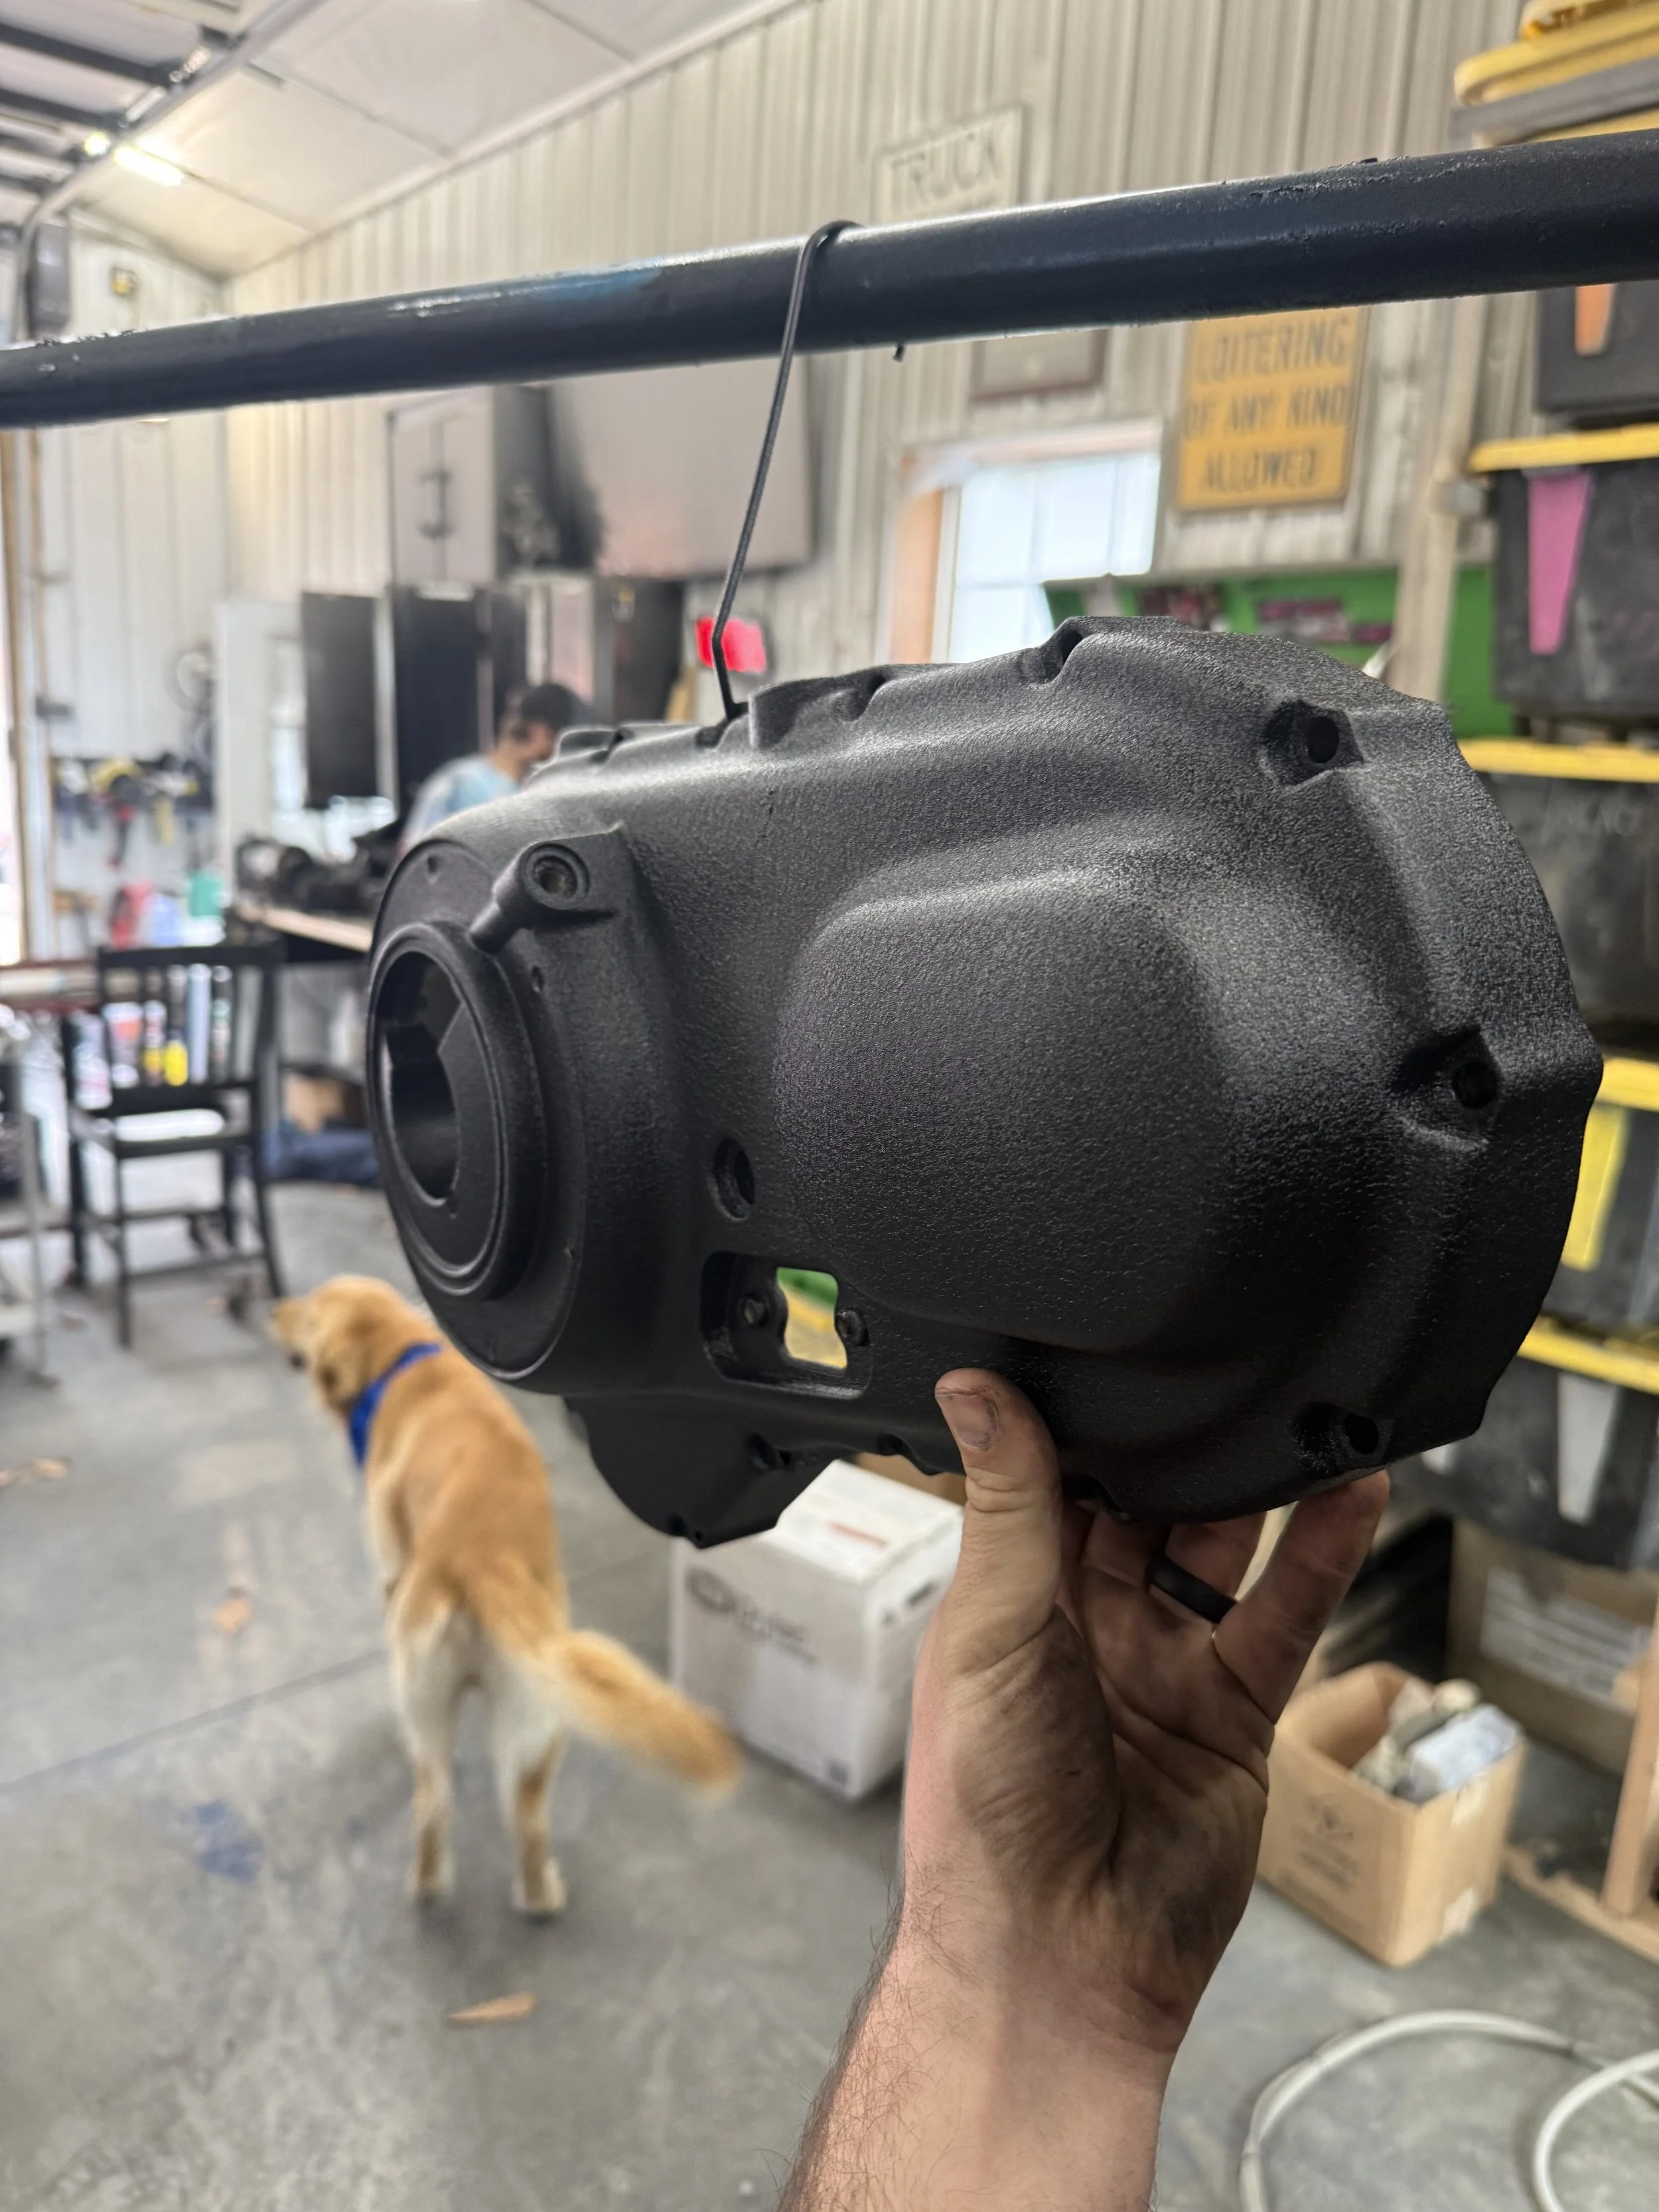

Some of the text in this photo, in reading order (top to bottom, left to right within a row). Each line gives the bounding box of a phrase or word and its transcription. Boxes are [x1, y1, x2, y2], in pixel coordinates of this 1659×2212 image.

[1192, 312, 1350, 385] LOITERING
[1183, 383, 1350, 441] OF ANY KIND
[1198, 443, 1319, 492] ALLOWED
